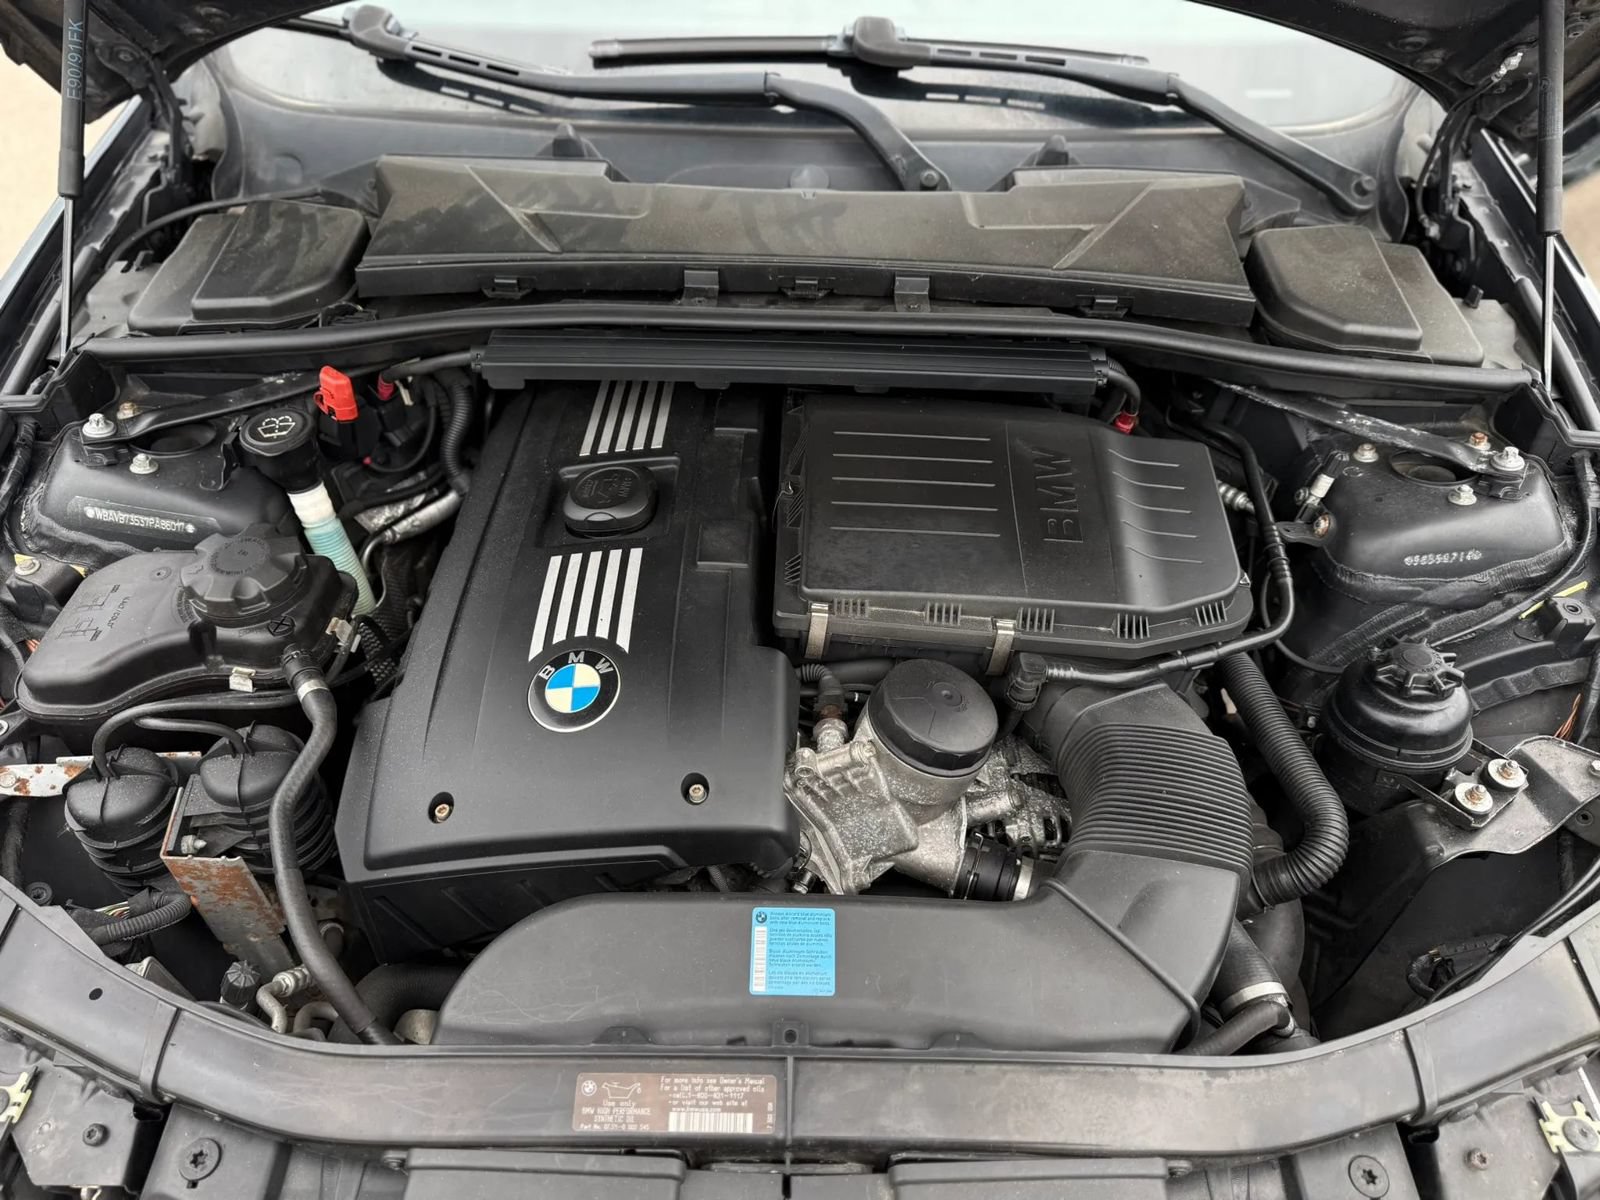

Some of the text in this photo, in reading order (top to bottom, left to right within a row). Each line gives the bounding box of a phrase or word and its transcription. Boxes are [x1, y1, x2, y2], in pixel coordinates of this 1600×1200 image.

[66, 18, 84, 100] E90/91FK
[1031, 449, 1084, 544] BMW
[538, 651, 614, 680] BMW
[660, 1083, 670, 1091] For
[723, 1085, 751, 1093] approved
[661, 1076, 671, 1084] For
[744, 1077, 765, 1085] Manual
[619, 1099, 636, 1109] only
